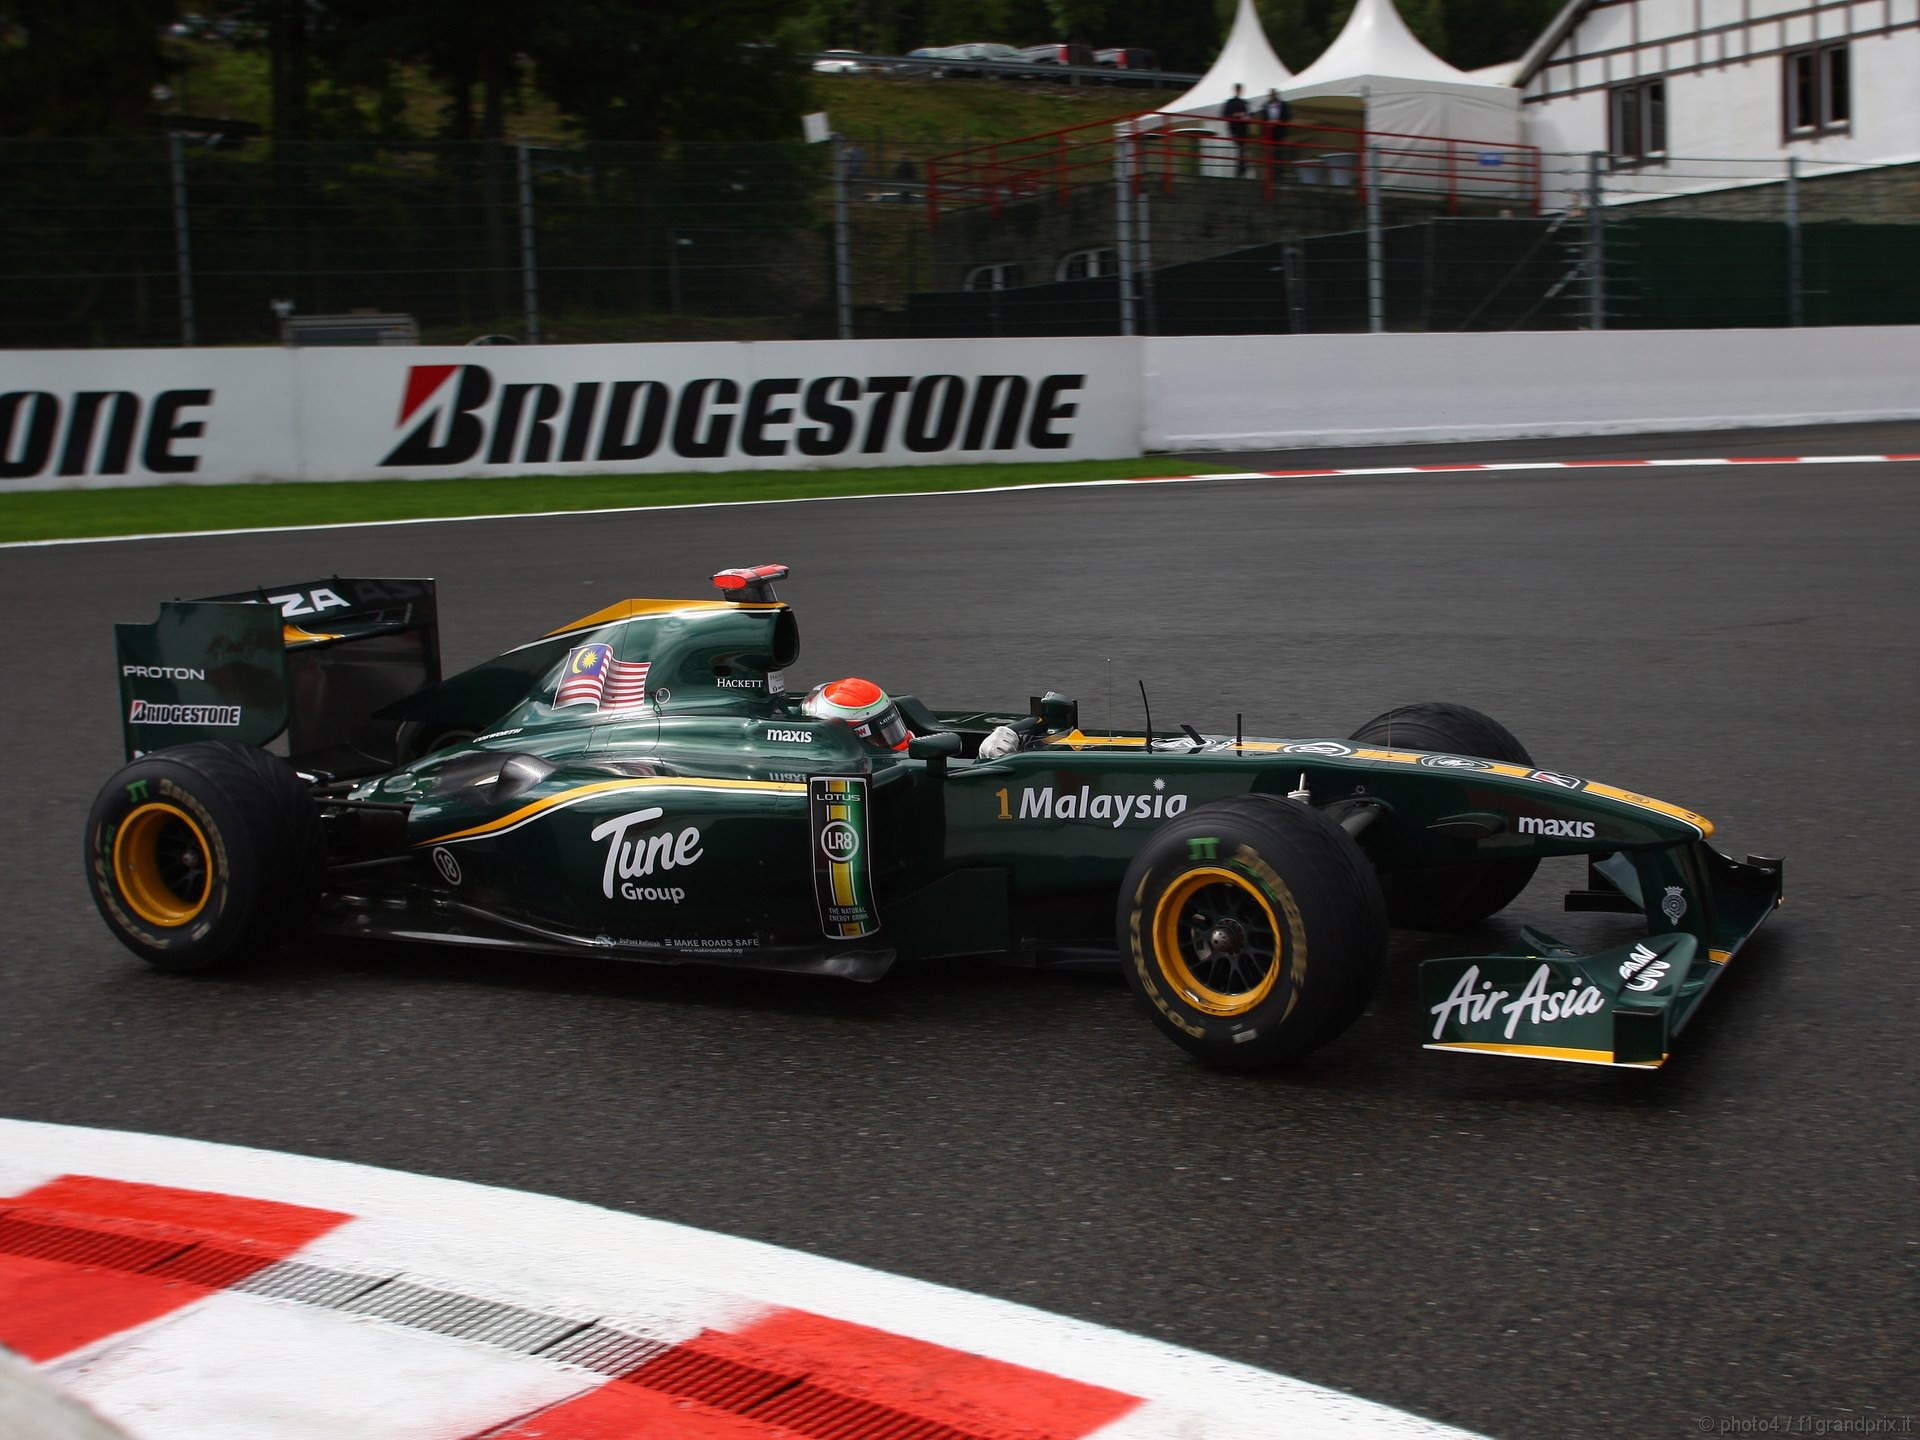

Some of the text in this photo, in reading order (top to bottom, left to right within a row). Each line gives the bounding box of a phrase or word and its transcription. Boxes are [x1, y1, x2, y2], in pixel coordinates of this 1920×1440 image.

[376, 363, 1088, 467] BRIDGESTONE
[0, 389, 215, 479] ONE
[240, 587, 351, 618] ZA
[122, 665, 206, 681] PROTON
[716, 678, 764, 688] HACKETT
[130, 701, 240, 725] BRIDGESTONE
[766, 728, 813, 744] maxis
[816, 793, 861, 802] LOTUS
[995, 778, 1188, 829] 1 Malaysia
[1518, 816, 1596, 839] maxis
[828, 831, 853, 850] LR8
[591, 806, 704, 899] Tune
[438, 851, 458, 878] 18
[621, 882, 686, 904] Group
[828, 906, 867, 915] THE NATURAL
[673, 938, 760, 947] MAKE ROADS SAFE
